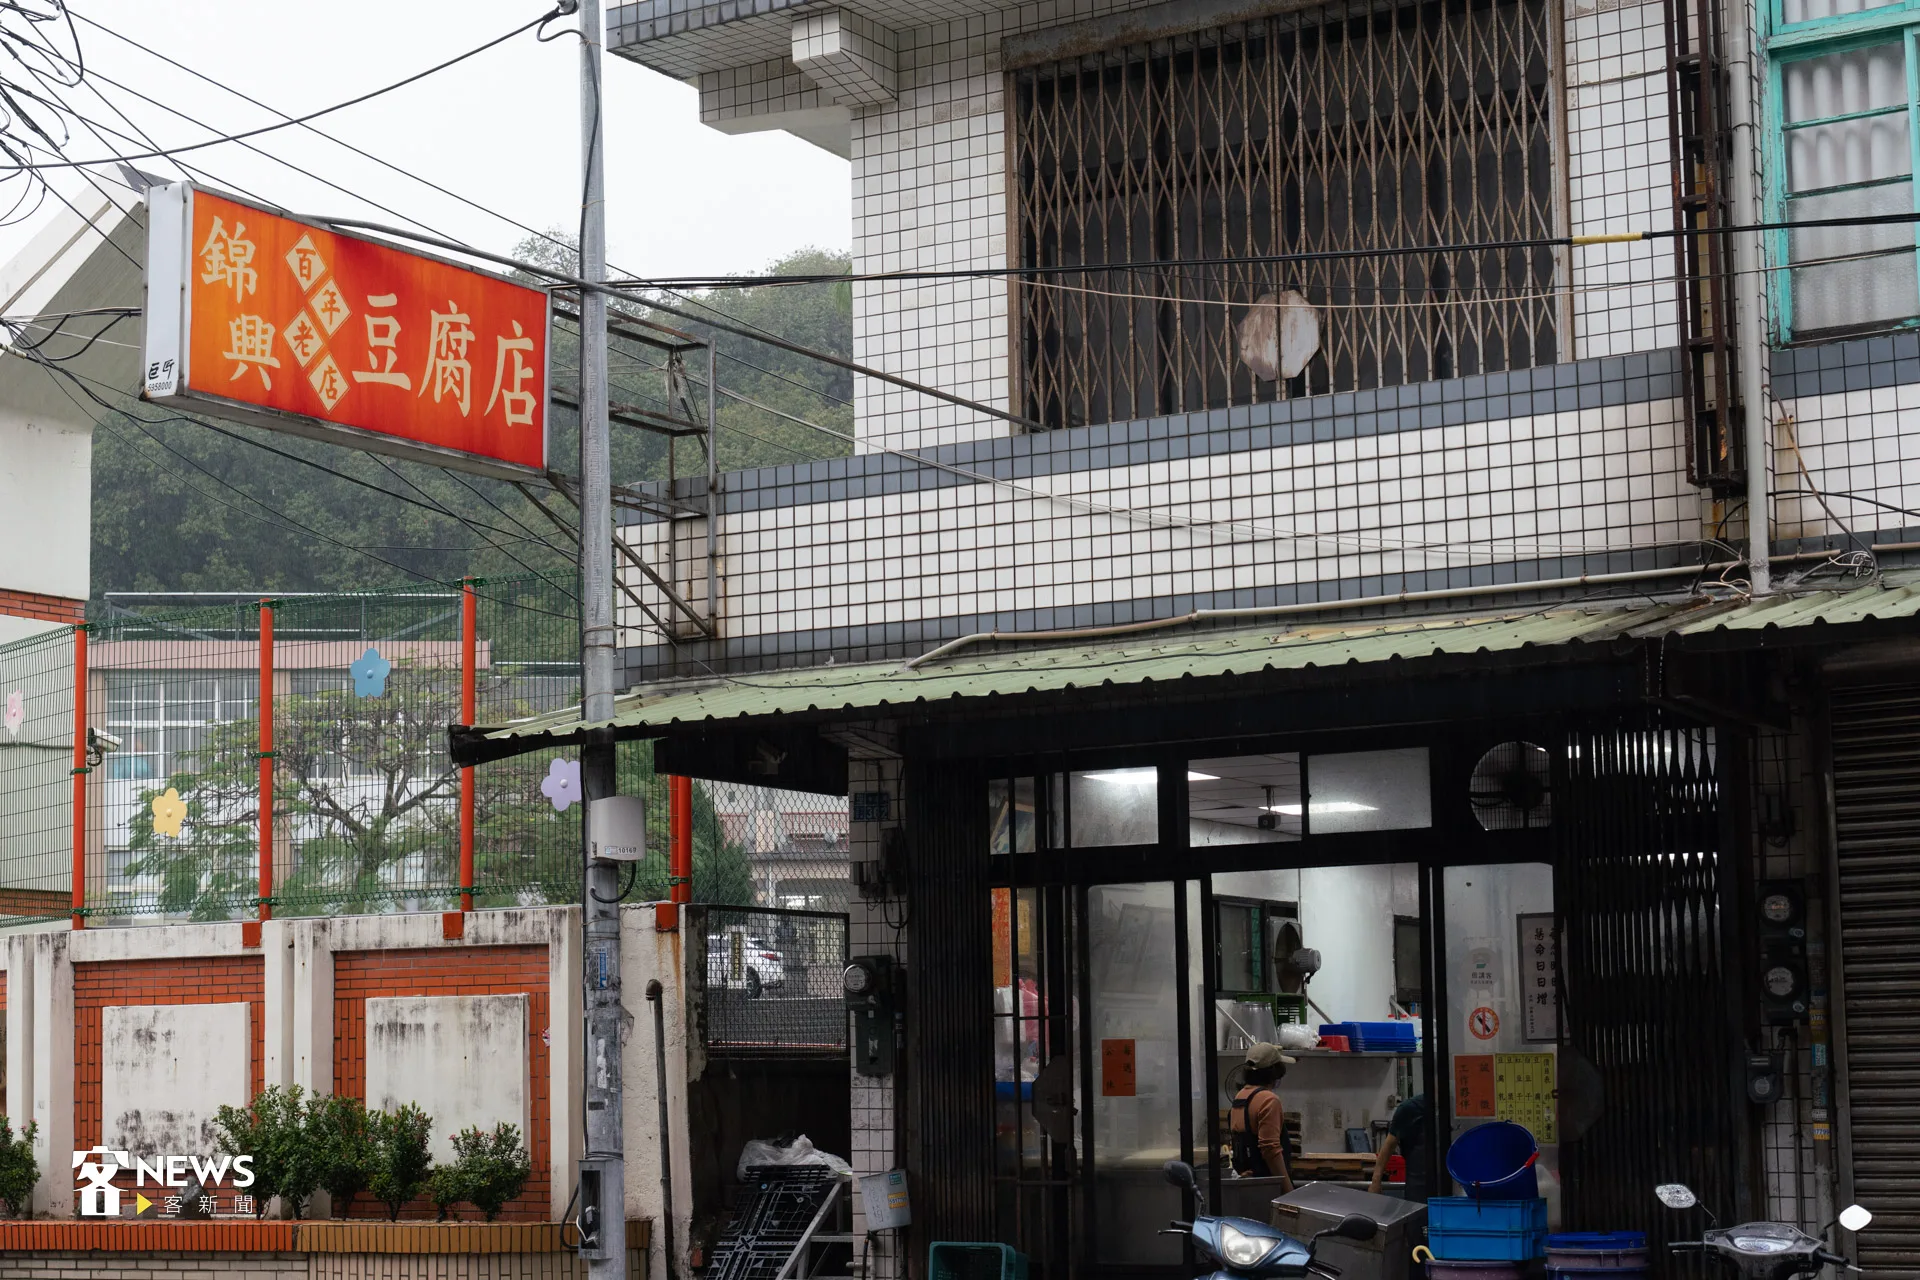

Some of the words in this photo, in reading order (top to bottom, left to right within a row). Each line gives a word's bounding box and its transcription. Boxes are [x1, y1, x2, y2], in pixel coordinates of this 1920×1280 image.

[148, 358, 175, 380] 巨匠
[200, 215, 280, 391] 錦興
[293, 248, 341, 401] 百年老店
[352, 293, 538, 428] 豆腐店
